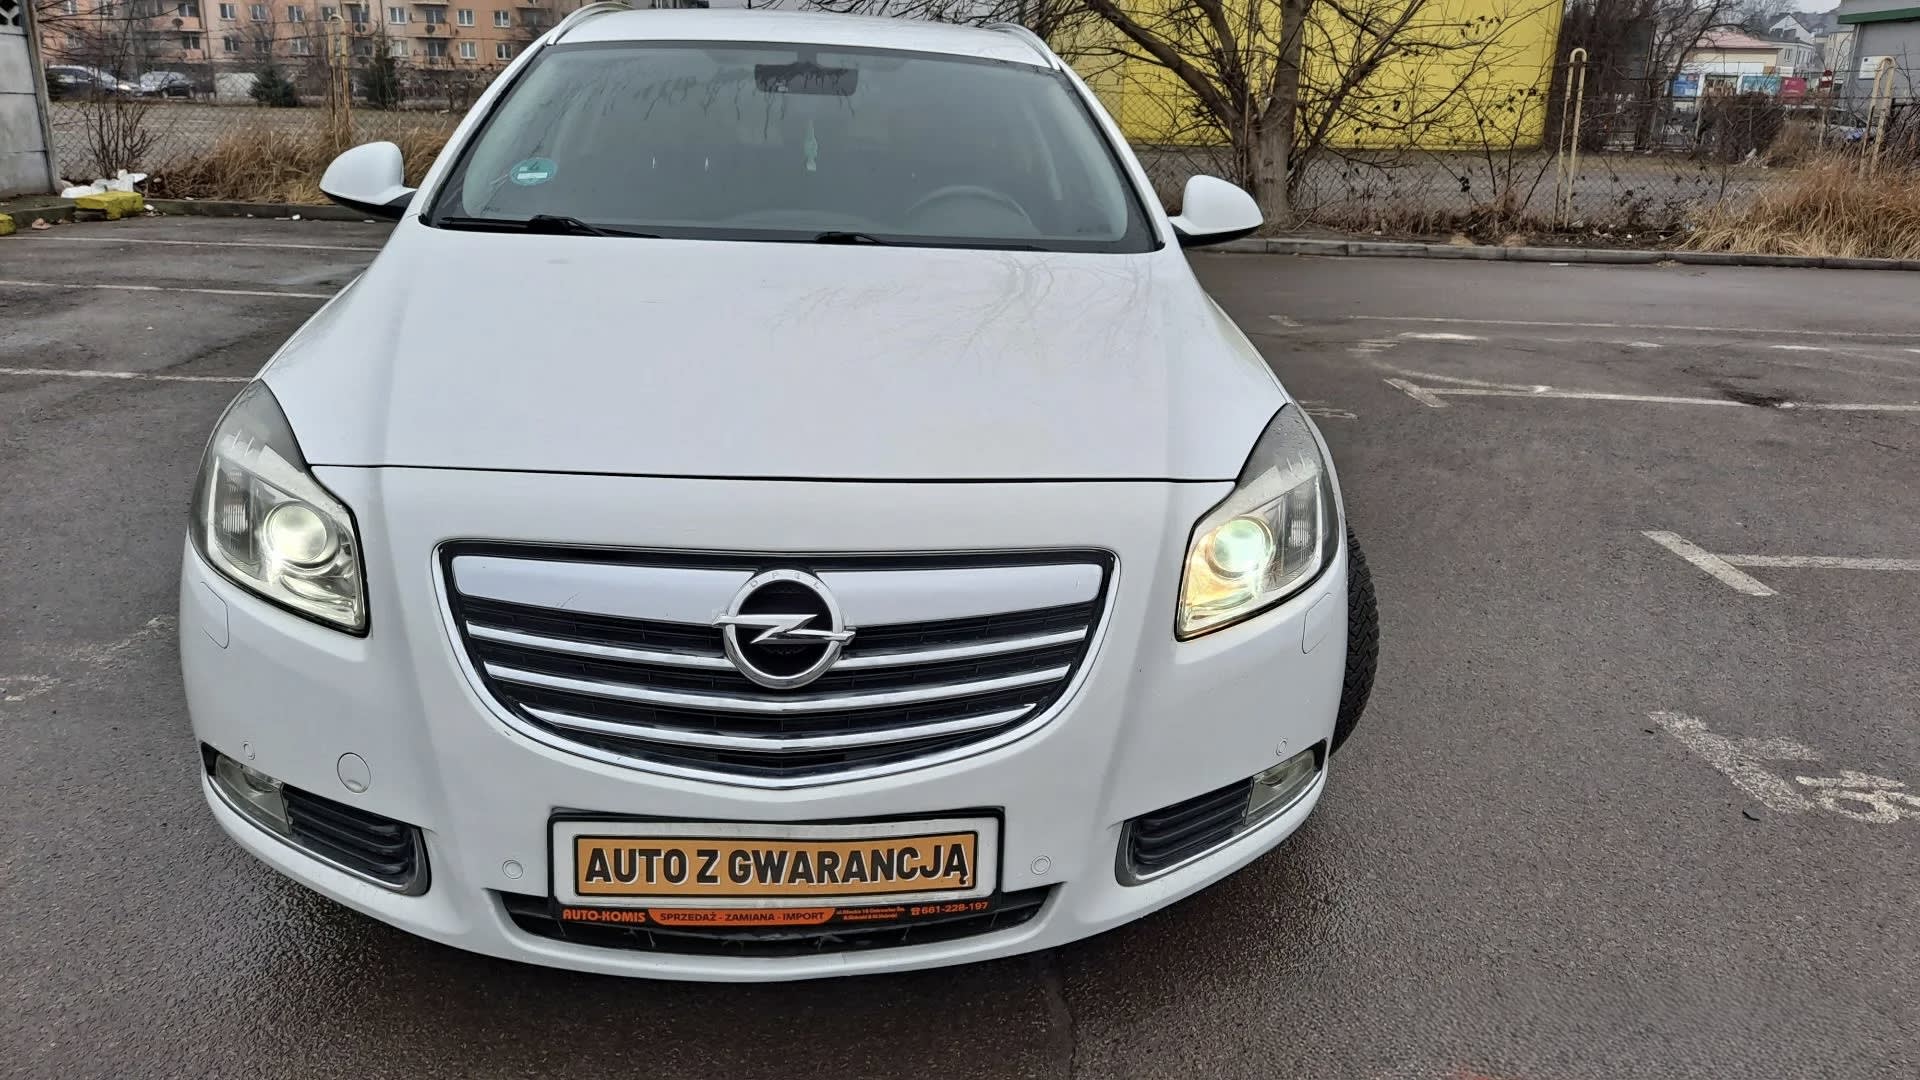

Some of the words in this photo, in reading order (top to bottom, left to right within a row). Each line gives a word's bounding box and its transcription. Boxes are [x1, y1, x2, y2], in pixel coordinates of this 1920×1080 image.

[585, 848, 688, 885] AUTO
[696, 849, 719, 884] Z
[728, 843, 969, 887] GWARANCJĄ
[562, 908, 646, 923] AUTO-KOMIS
[660, 912, 717, 921] SPRZEDAŻ
[725, 913, 775, 921] ZAMIANA
[783, 911, 825, 921] IMPORT
